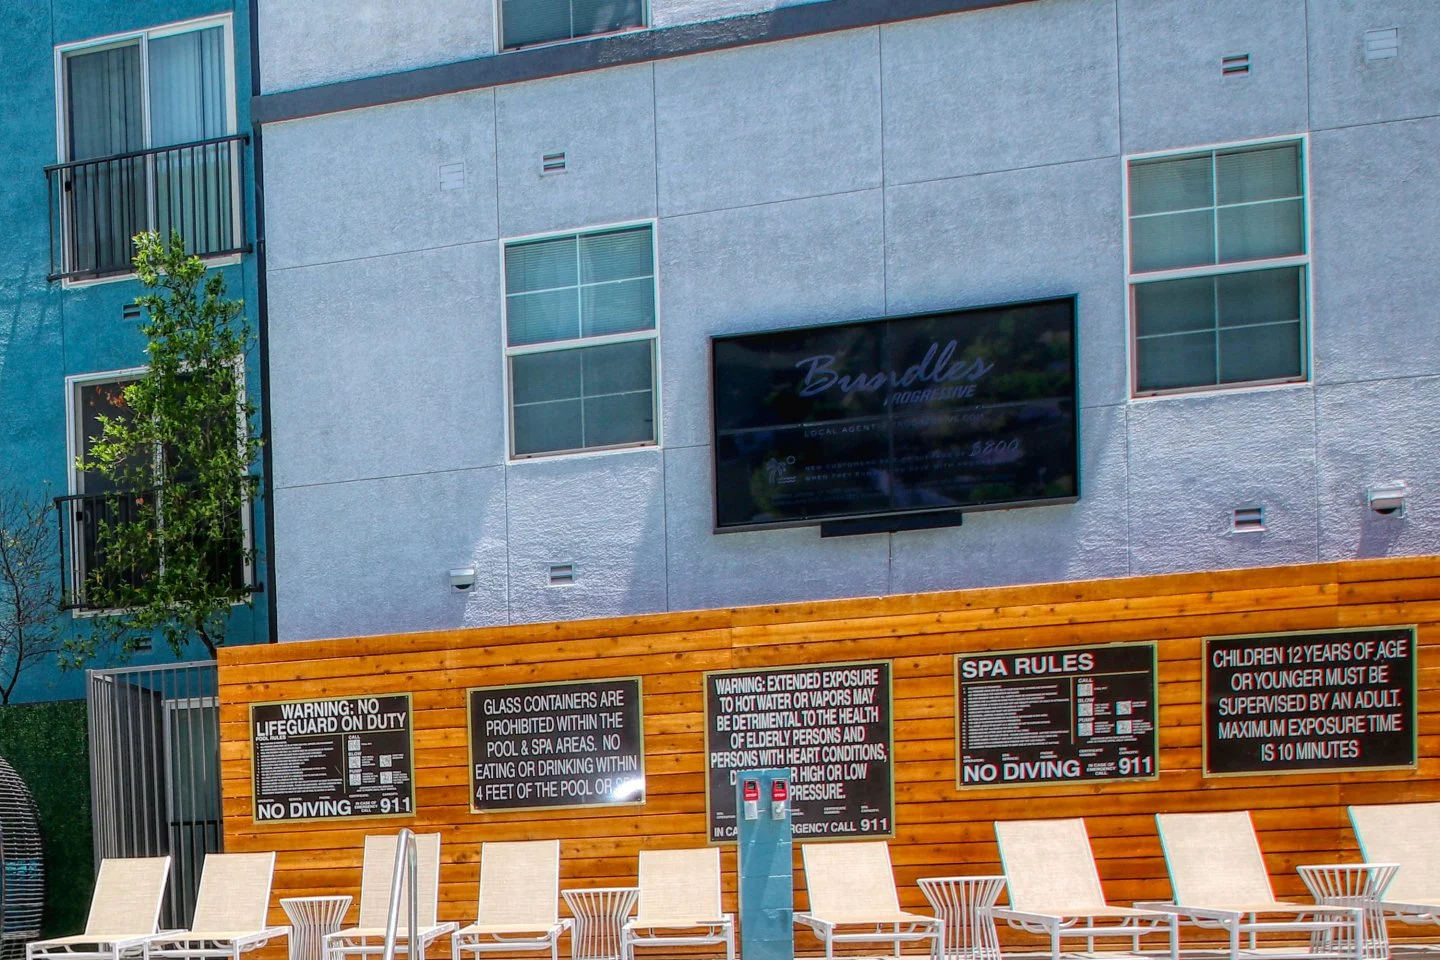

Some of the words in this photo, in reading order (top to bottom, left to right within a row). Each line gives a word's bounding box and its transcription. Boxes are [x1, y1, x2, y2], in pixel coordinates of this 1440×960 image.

[796, 339, 994, 398] Bundles
[969, 437, 1020, 457] $800
[962, 659, 1007, 678] SPA
[1014, 653, 1095, 675] RULES
[1213, 646, 1283, 668] CHILDREN
[1287, 646, 1301, 664] 12
[1303, 643, 1351, 662] YEARS
[1354, 642, 1374, 660] OF
[1376, 640, 1407, 659] AGE
[715, 677, 766, 694] WARNING:
[767, 673, 820, 691] EXTENDED
[823, 669, 879, 688] EXPOSURE
[1231, 673, 1253, 691] OR
[1254, 669, 1323, 690] YOUNGER
[1325, 667, 1367, 686] MUST
[1369, 665, 1389, 683] BE
[281, 701, 354, 720] WARNING:
[358, 698, 379, 714] NO
[484, 697, 521, 715] GLASS
[524, 691, 597, 713] CONTAINERS
[600, 690, 624, 707] ARE
[719, 697, 733, 713] TO
[735, 696, 757, 712] HOT
[757, 693, 791, 711] WATER
[793, 692, 809, 708] OR
[809, 690, 851, 707] VAPORS
[853, 688, 875, 704] MAY
[1219, 694, 1306, 716] SUPERVISED
[1310, 693, 1330, 711] BY
[1331, 692, 1352, 710] AN
[1354, 689, 1402, 709] ADULT.
[256, 717, 337, 737] LIFEGUARD
[342, 715, 362, 731] ON
[367, 712, 406, 729] DUTY
[486, 716, 554, 736] PROHIBITED
[557, 714, 598, 732] WITHIN
[599, 712, 623, 729] THE
[717, 715, 731, 731] BE
[732, 711, 801, 730] DETRIMENTAL
[802, 710, 816, 726] TO
[817, 709, 837, 725] THE
[838, 706, 879, 723] HEALTH
[1218, 720, 1285, 740] MAXIMUM
[1288, 715, 1367, 736] EXPOSURE
[1367, 714, 1402, 732] TIME
[487, 741, 518, 757] POOL
[521, 740, 529, 756] &
[531, 738, 553, 755] SPA
[556, 735, 597, 753] AREAS.
[602, 734, 620, 750] NO
[730, 733, 745, 749] OF
[747, 730, 791, 748] ELDERLY
[792, 728, 841, 745] PERSONS
[843, 726, 865, 742] AND
[711, 751, 758, 768] PERSONS
[759, 749, 784, 766] WITH
[785, 747, 821, 764] HEART
[822, 743, 887, 763] CONDITIONS,
[1261, 743, 1273, 762] IS
[1278, 743, 1293, 760] 10
[1296, 740, 1359, 760] MINUTES
[475, 761, 515, 780] EATING
[518, 761, 535, 777] OR
[538, 757, 593, 777] DRINKING
[595, 755, 637, 772] WITHIN
[800, 765, 825, 782] HIGH
[827, 765, 843, 781] OR
[844, 763, 867, 780] LOW
[963, 764, 997, 782] NO
[1003, 759, 1081, 780] DIVING
[1118, 756, 1151, 774] 911
[476, 785, 483, 801] 4
[485, 784, 514, 801] FEET
[517, 782, 532, 799] OF
[534, 781, 557, 797] THE
[560, 779, 592, 796] POOL
[595, 778, 612, 794] OR
[790, 783, 846, 800] PRESSURE.
[258, 803, 285, 819] NO
[290, 800, 351, 818] DIVING
[380, 797, 410, 813] 911
[714, 826, 724, 837] IN
[725, 826, 738, 836] CA
[790, 822, 829, 834] RGENCY
[830, 820, 856, 833] CALL
[861, 818, 887, 831] 911
